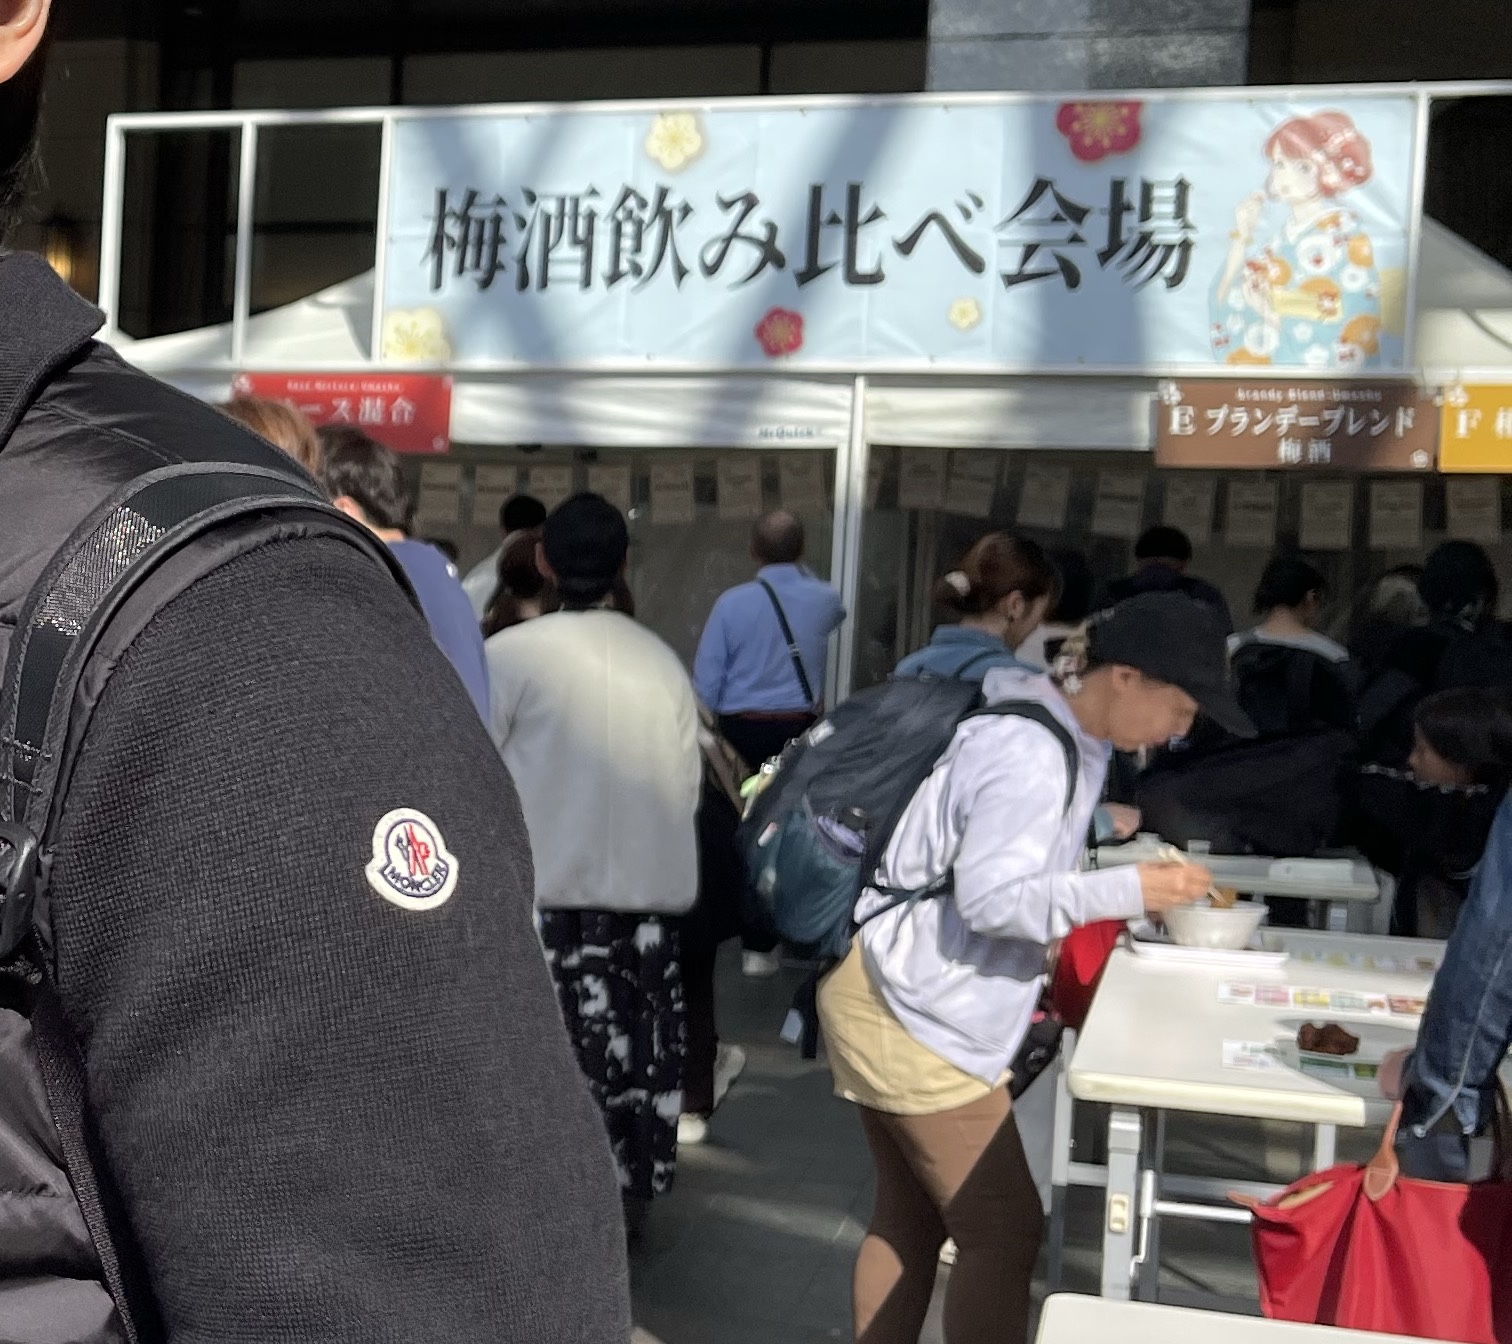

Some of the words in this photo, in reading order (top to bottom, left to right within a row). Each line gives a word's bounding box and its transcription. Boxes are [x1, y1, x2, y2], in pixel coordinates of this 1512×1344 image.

[420, 174, 1198, 296] 梅酒飲み比べ会場
[1205, 404, 1416, 438] ブランデーブレンド
[386, 862, 447, 893] MONCLER
